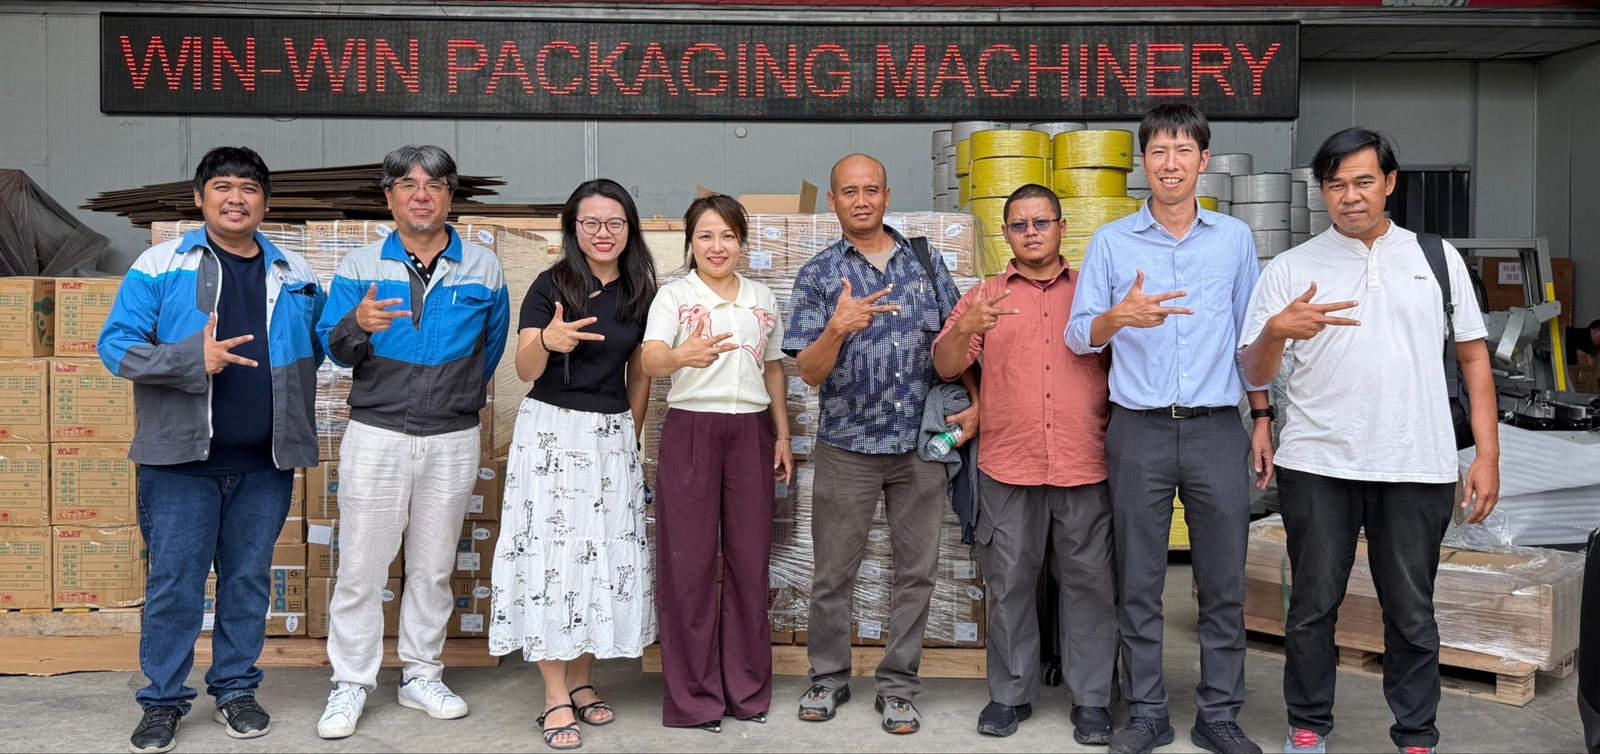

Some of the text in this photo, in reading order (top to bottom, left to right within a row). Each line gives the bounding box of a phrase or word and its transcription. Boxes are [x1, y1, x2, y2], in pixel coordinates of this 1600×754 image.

[119, 35, 1281, 97] WIN-WIN PACKAGING MACHINERY
